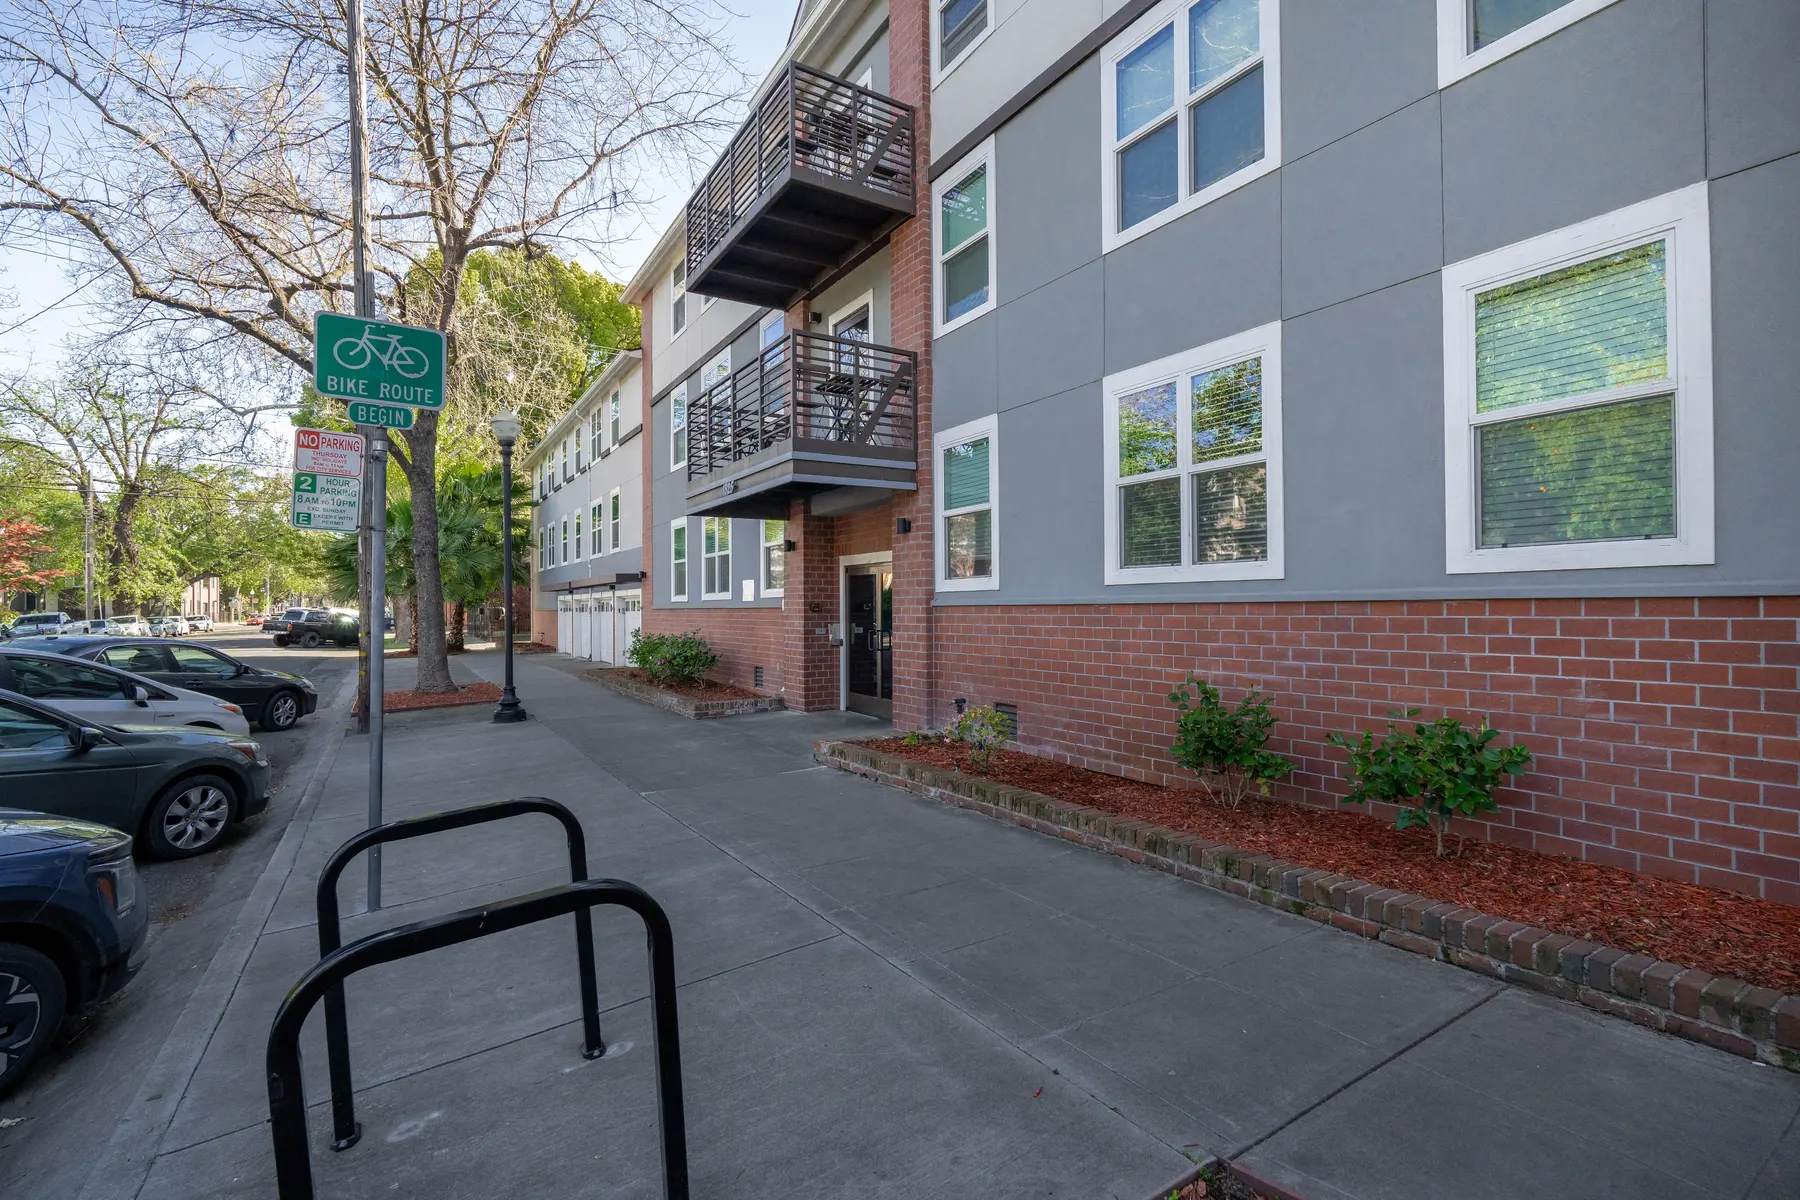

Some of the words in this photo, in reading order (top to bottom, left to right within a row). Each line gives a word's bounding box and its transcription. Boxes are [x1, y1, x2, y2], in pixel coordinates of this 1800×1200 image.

[327, 375, 368, 395] BIKE
[379, 382, 434, 404] ROUTE
[358, 406, 404, 425] BEGIN
[300, 433, 318, 447] NO
[321, 437, 360, 452] PARKING
[312, 451, 347, 459] THURSDAY
[300, 476, 312, 490] 2
[326, 478, 350, 487] HOUR
[320, 487, 357, 498] PARKING
[300, 514, 308, 523] E
